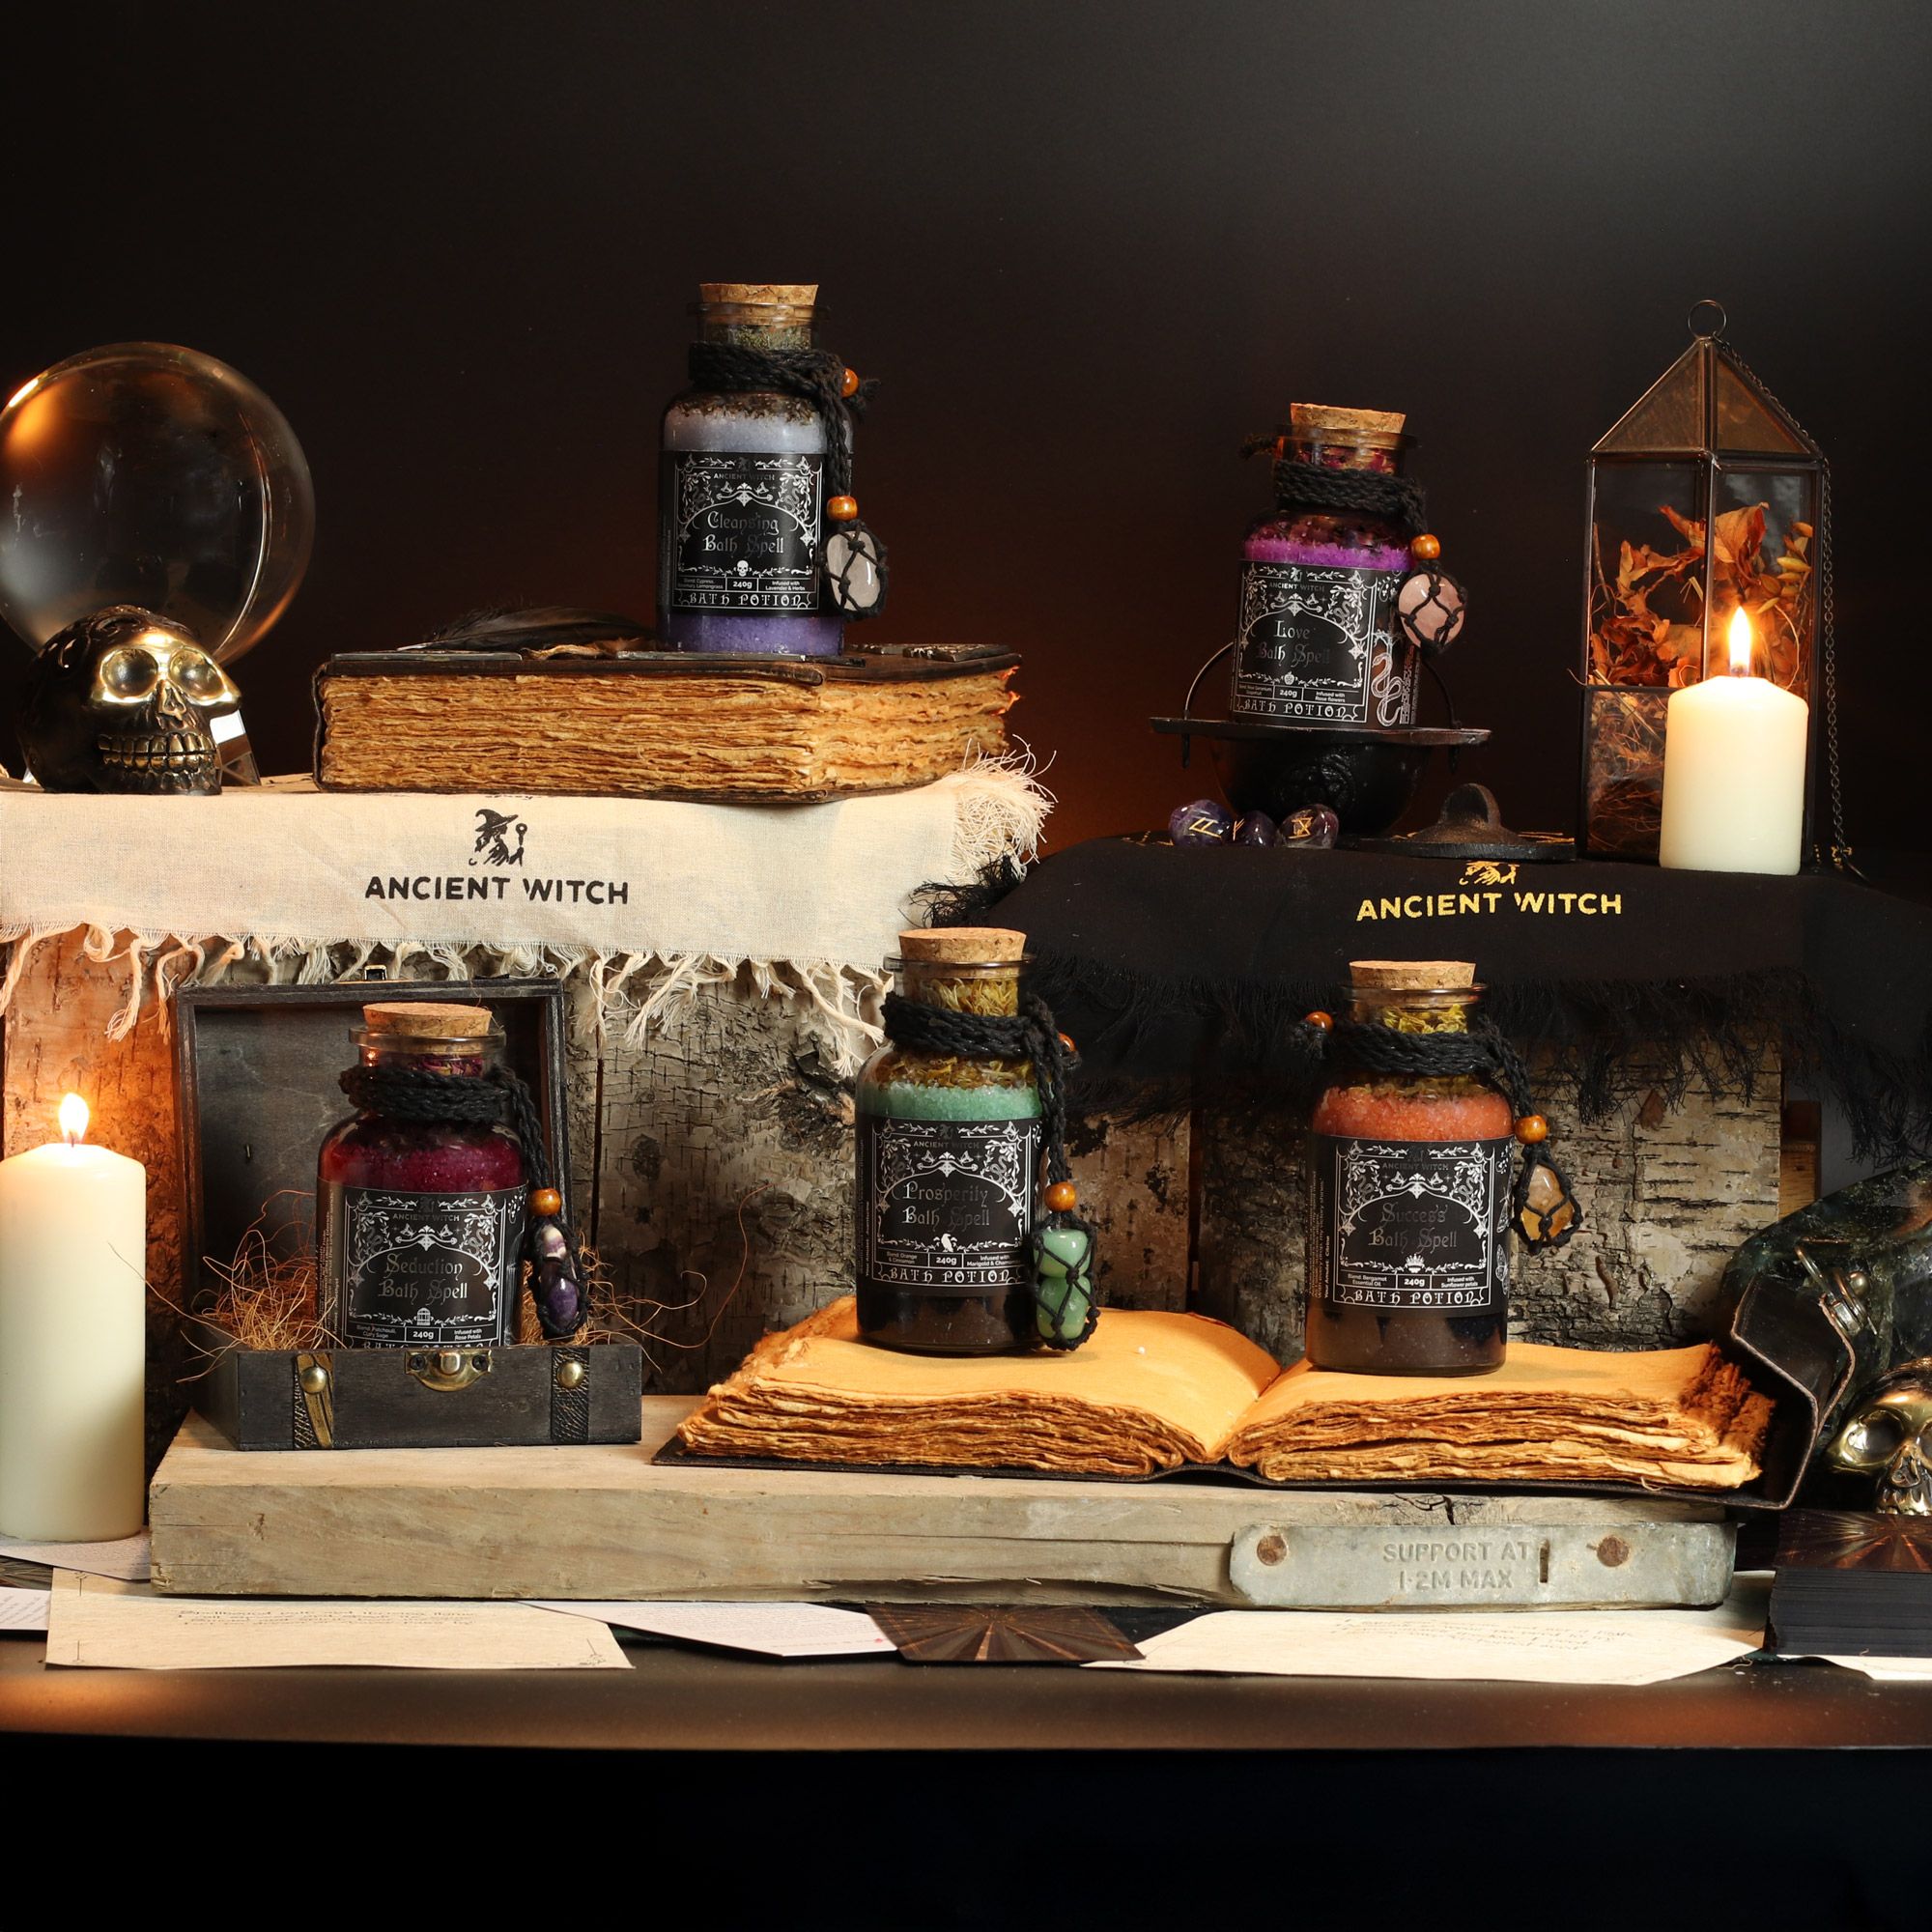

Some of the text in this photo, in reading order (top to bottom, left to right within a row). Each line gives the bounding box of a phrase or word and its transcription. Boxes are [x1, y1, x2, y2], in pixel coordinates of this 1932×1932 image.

[707, 510, 780, 535] Cleansing
[702, 533, 784, 557] Bath Spell
[732, 581, 753, 589] 240g
[1268, 582, 1325, 592] ANCIENT WITCH
[689, 592, 801, 607] BATH POTION
[1273, 619, 1310, 639] Love
[1257, 641, 1330, 668] Bath Spell
[1279, 689, 1297, 698] 240g
[1244, 698, 1347, 718] BATH POTION
[365, 876, 629, 904] ANCIENT WITCH
[1355, 892, 1622, 922] ANCIENT WITCH
[913, 1140, 950, 1149] ANCIENT
[1381, 1162, 1449, 1171] ANCIENT WITCH
[902, 1180, 988, 1208] Prosperity
[392, 1212, 460, 1222] ANCIENT WITCH
[902, 1206, 990, 1232] Bath Spell
[1379, 1202, 1448, 1227] Success
[1368, 1227, 1457, 1254] Bath Spell
[384, 1252, 464, 1280] Seduction
[935, 1257, 957, 1265] 240g
[890, 1267, 1009, 1283] BATH POTION
[1404, 1278, 1425, 1287] 240g
[378, 1279, 468, 1305] Bath Spell
[1353, 1290, 1474, 1305] BATH POTION
[412, 1330, 434, 1340] 240g
[1382, 1541, 1532, 1563] SUPPORT AT
[1460, 1569, 1515, 1589] MAX
